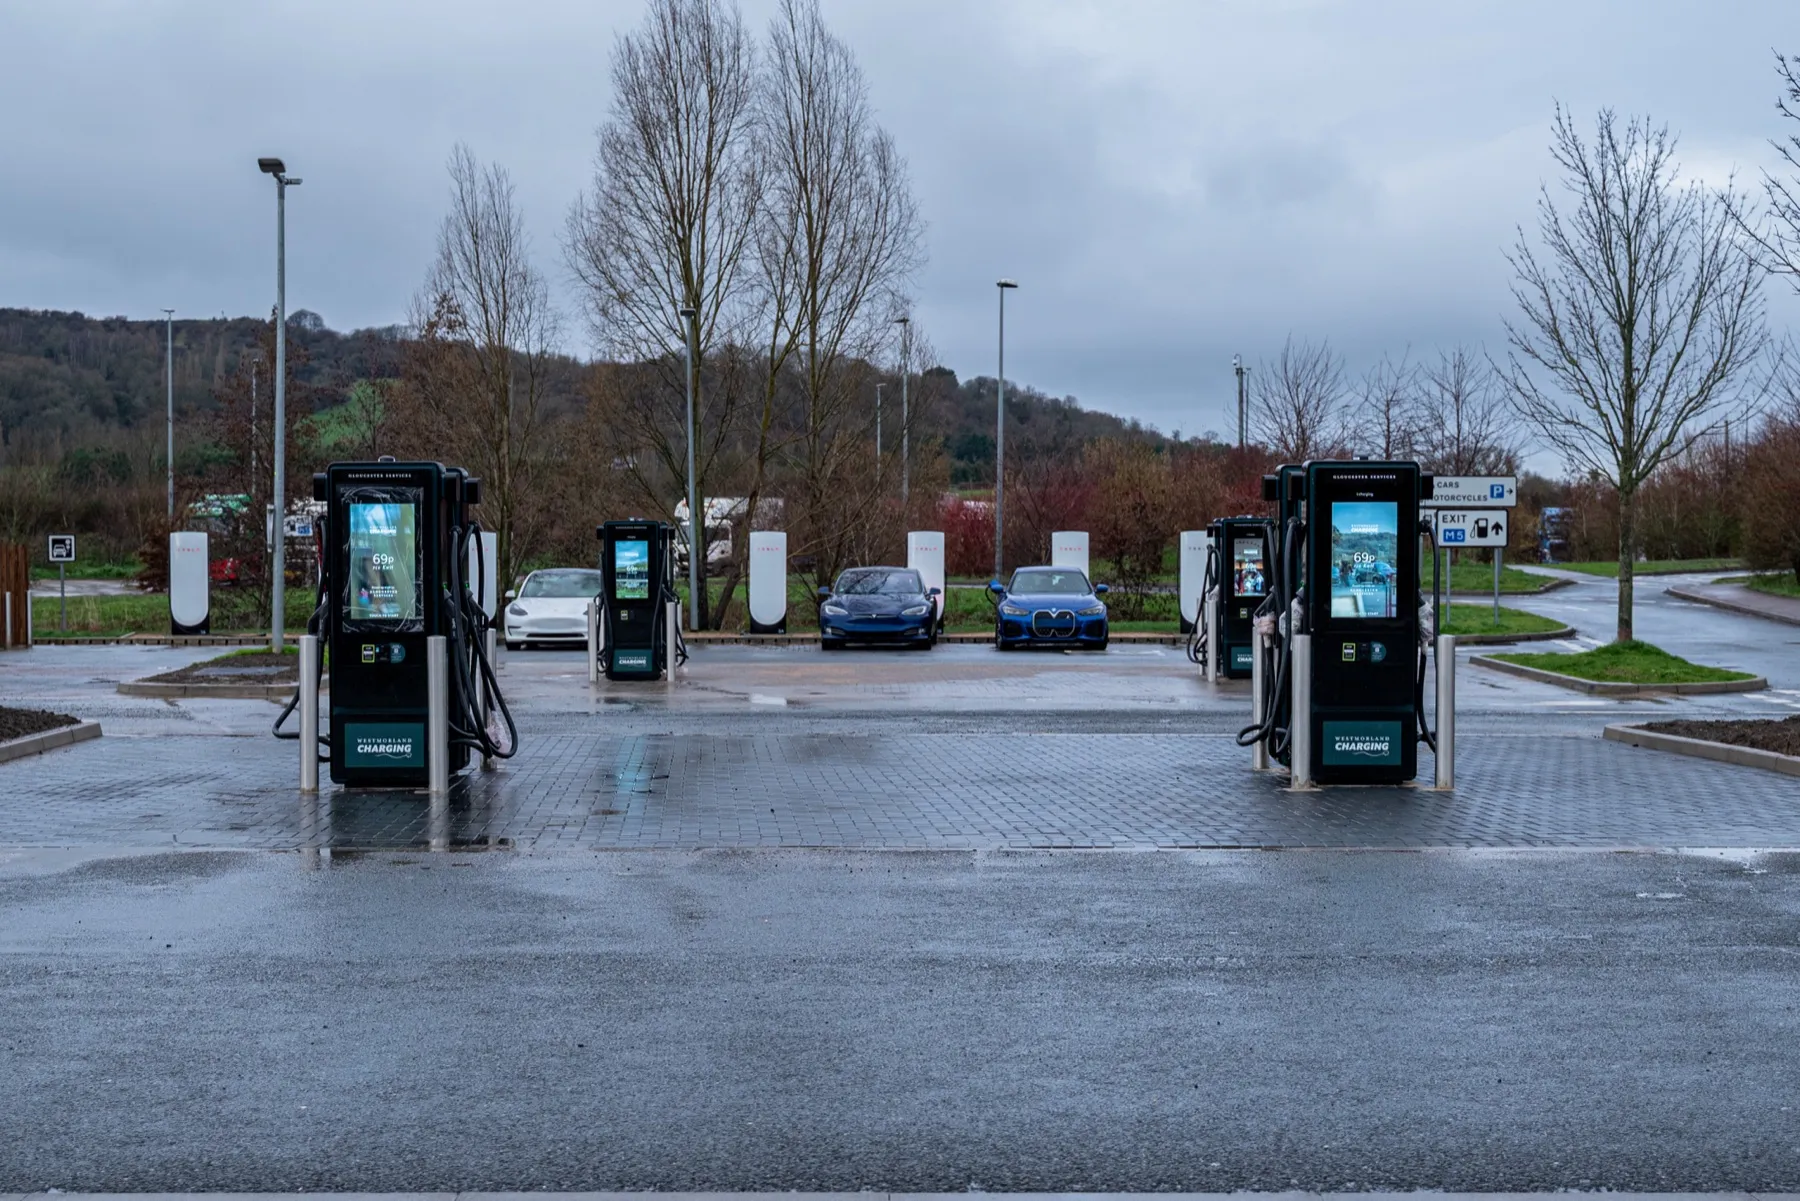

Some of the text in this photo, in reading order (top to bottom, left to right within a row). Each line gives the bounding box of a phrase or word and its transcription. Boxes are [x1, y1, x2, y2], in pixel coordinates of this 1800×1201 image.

[1442, 514, 1467, 523] EXIT
[1446, 531, 1464, 540] M5
[372, 553, 394, 565] 69p
[1354, 552, 1375, 563] 69p
[357, 744, 412, 753] CHARGING
[1335, 742, 1389, 751] CHARGING
